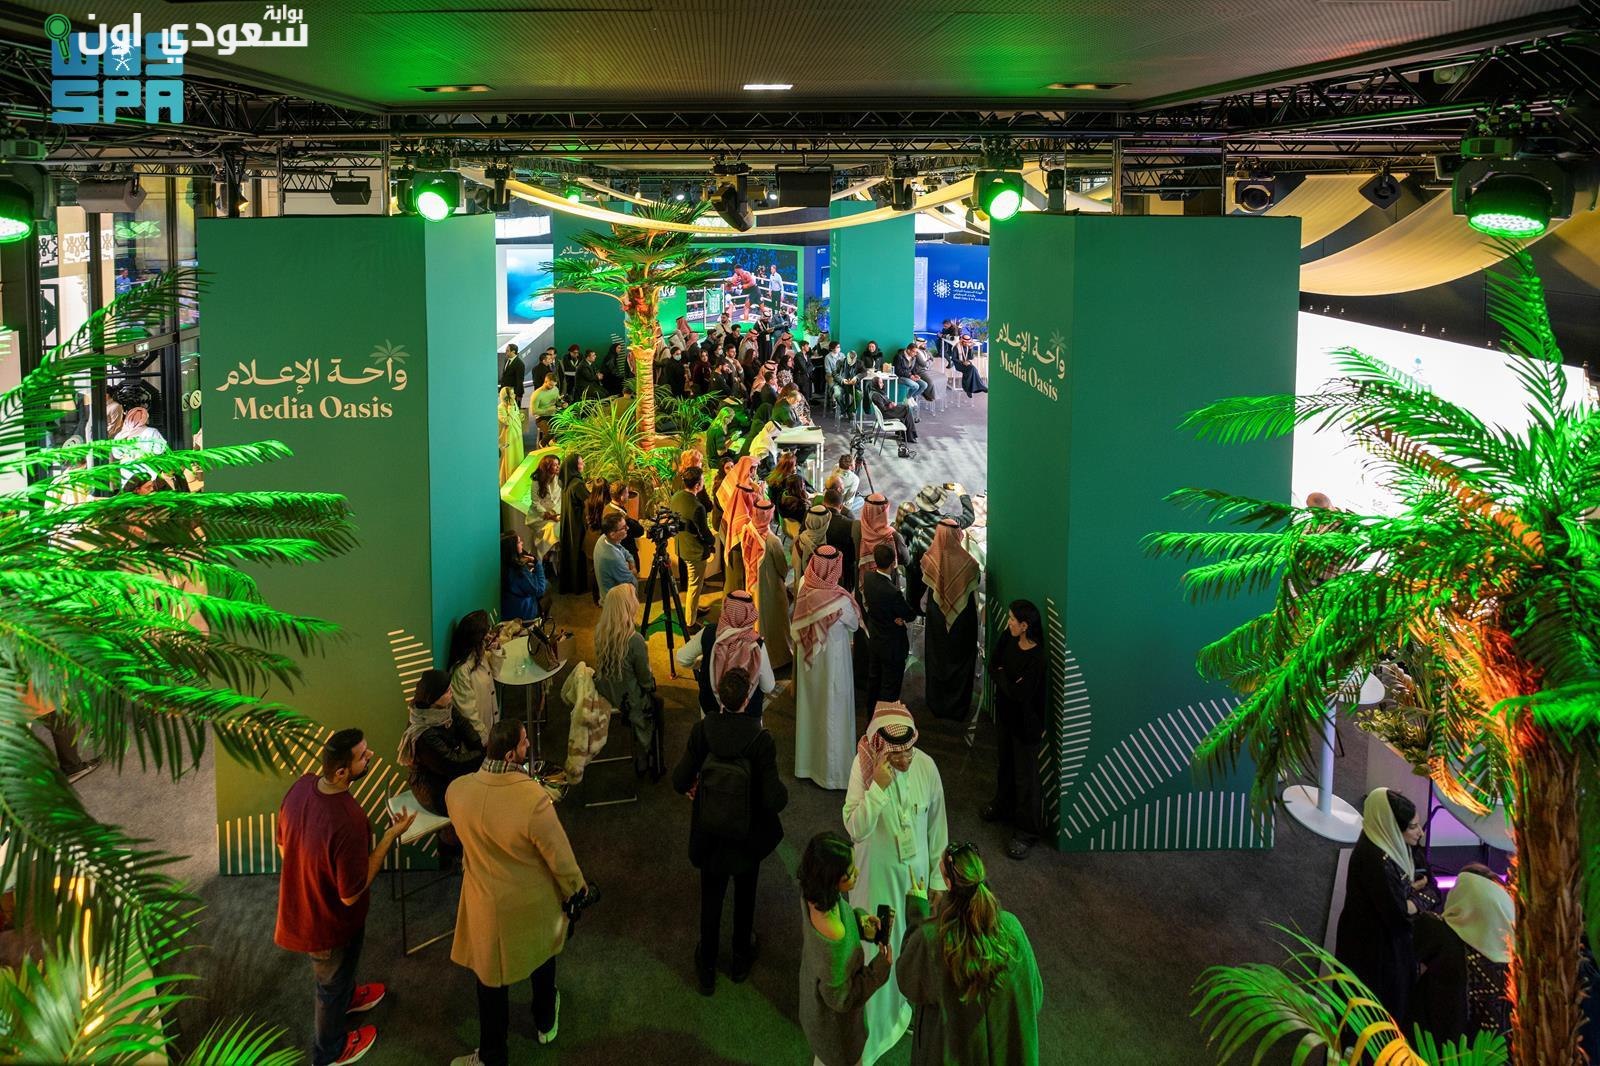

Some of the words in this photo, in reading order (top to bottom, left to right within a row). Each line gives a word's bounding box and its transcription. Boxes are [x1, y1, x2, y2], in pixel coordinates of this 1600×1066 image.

[953, 279, 985, 290] SDAIA
[995, 321, 1031, 359] الإعلام
[1032, 335, 1066, 380] واحة
[216, 357, 319, 394] الإعلام
[327, 357, 408, 391] واحة
[1000, 350, 1027, 383] Media
[1028, 367, 1058, 402] Oasis
[232, 395, 315, 420] Media
[319, 395, 393, 419] Oasis
